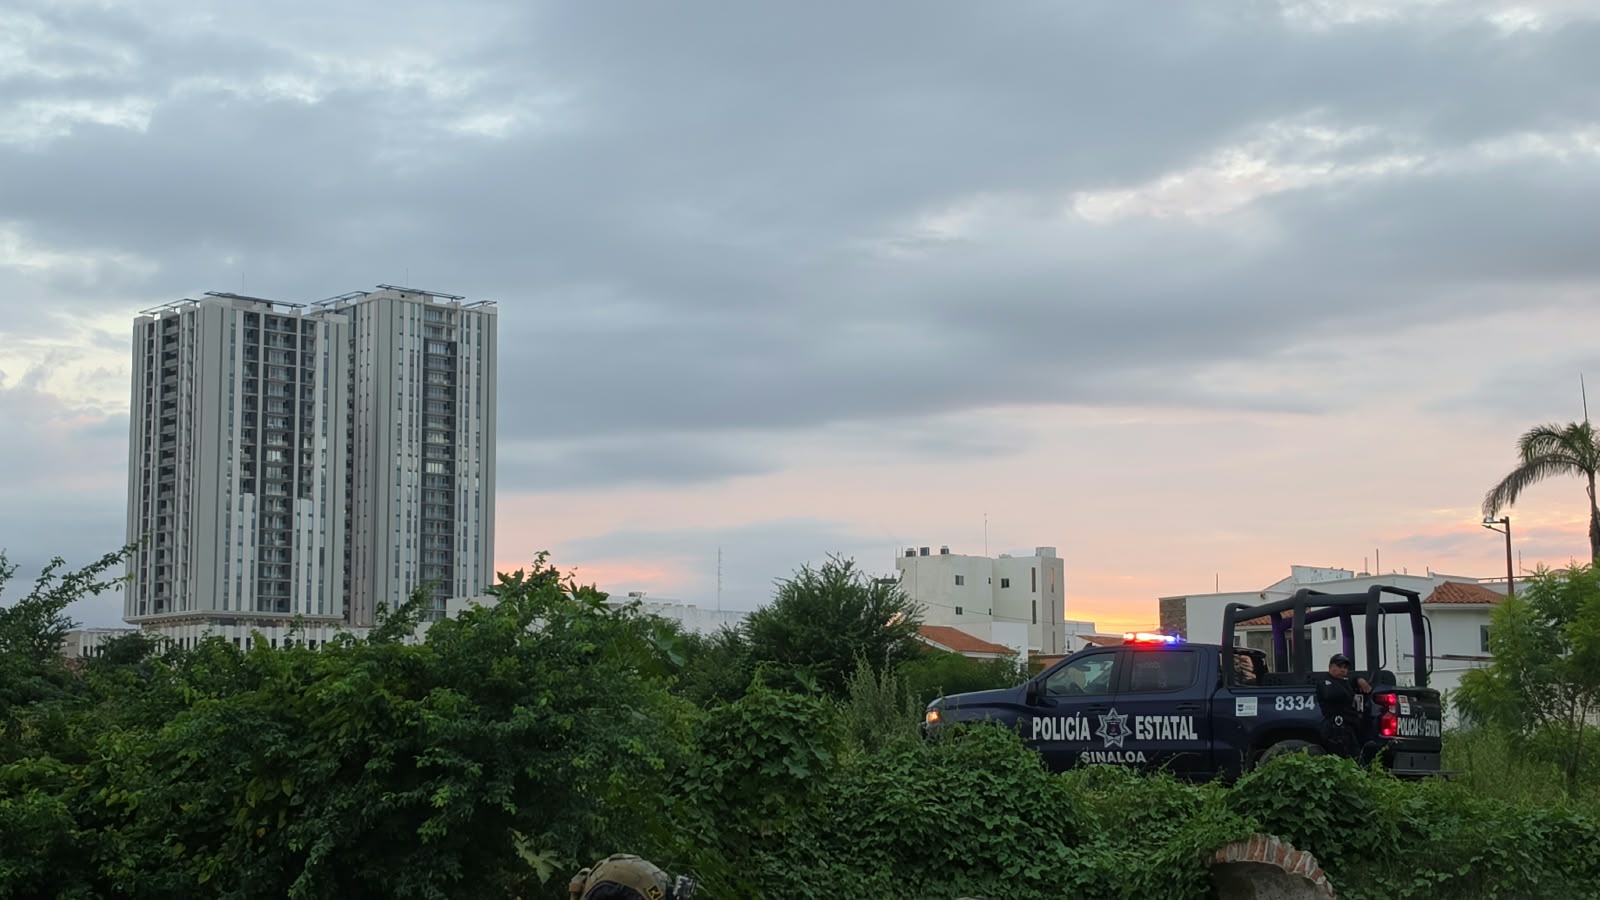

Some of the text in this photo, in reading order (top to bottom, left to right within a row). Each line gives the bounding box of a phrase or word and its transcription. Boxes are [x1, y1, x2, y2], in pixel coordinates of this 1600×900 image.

[1275, 695, 1315, 711] 8334
[1032, 711, 1198, 740] POLICÍA ESTATAL
[1081, 751, 1147, 763] SINALOA
